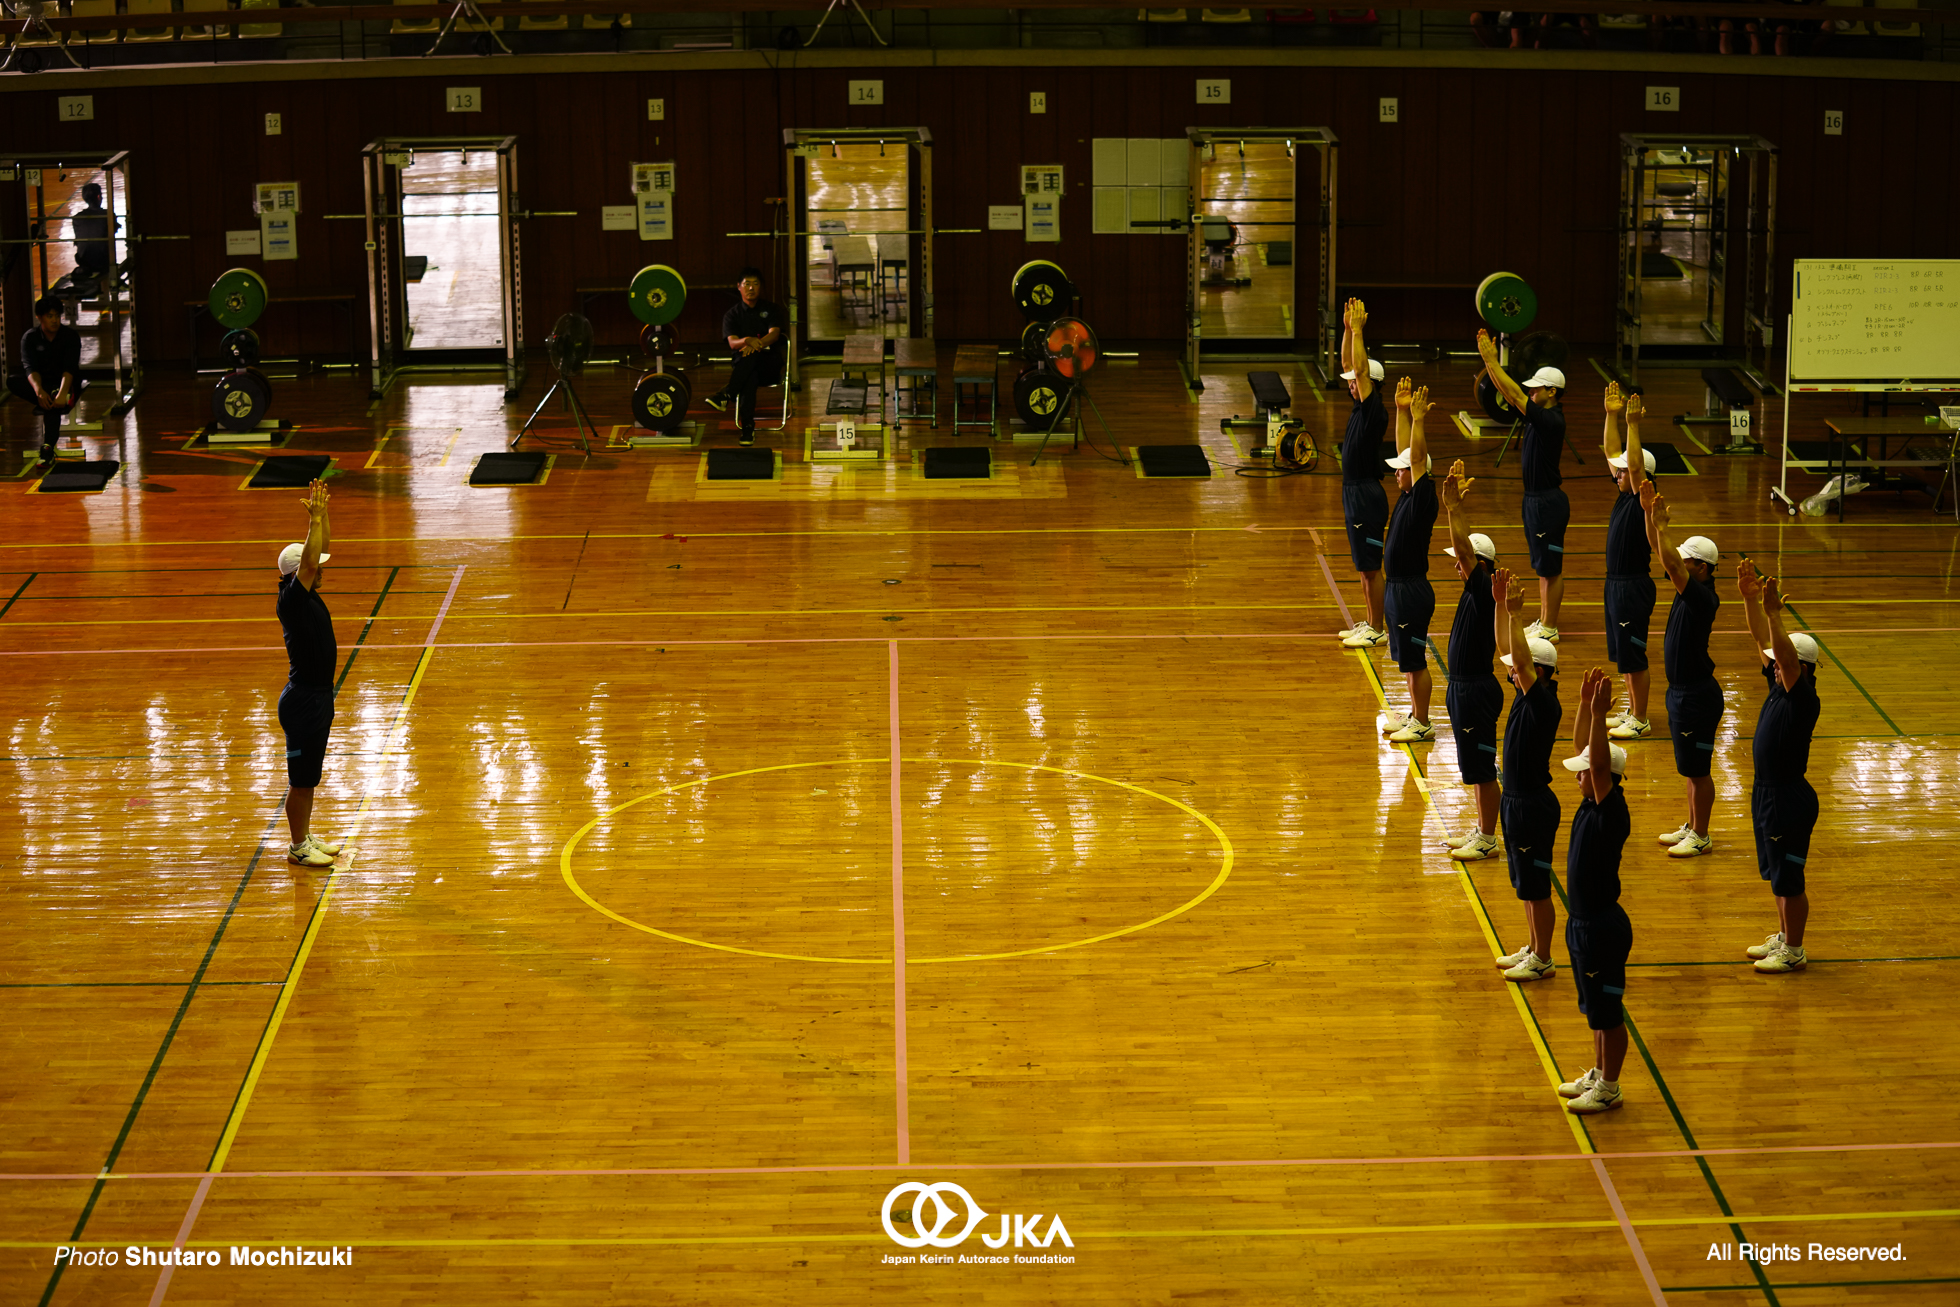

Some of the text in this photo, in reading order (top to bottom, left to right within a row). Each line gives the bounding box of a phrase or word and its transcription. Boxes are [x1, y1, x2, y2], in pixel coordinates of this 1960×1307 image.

[858, 87, 875, 100] 14
[1206, 85, 1221, 98] 15
[456, 94, 473, 107] 13
[1032, 98, 1043, 107] 14
[1654, 92, 1671, 105] 16
[67, 103, 85, 116] 12
[651, 104, 662, 114] 13
[1382, 105, 1395, 116] 15
[268, 118, 279, 128] 12
[1826, 116, 1841, 128] 16
[27, 170, 39, 180] 12
[1732, 415, 1748, 428] 16
[839, 427, 854, 440] 15
